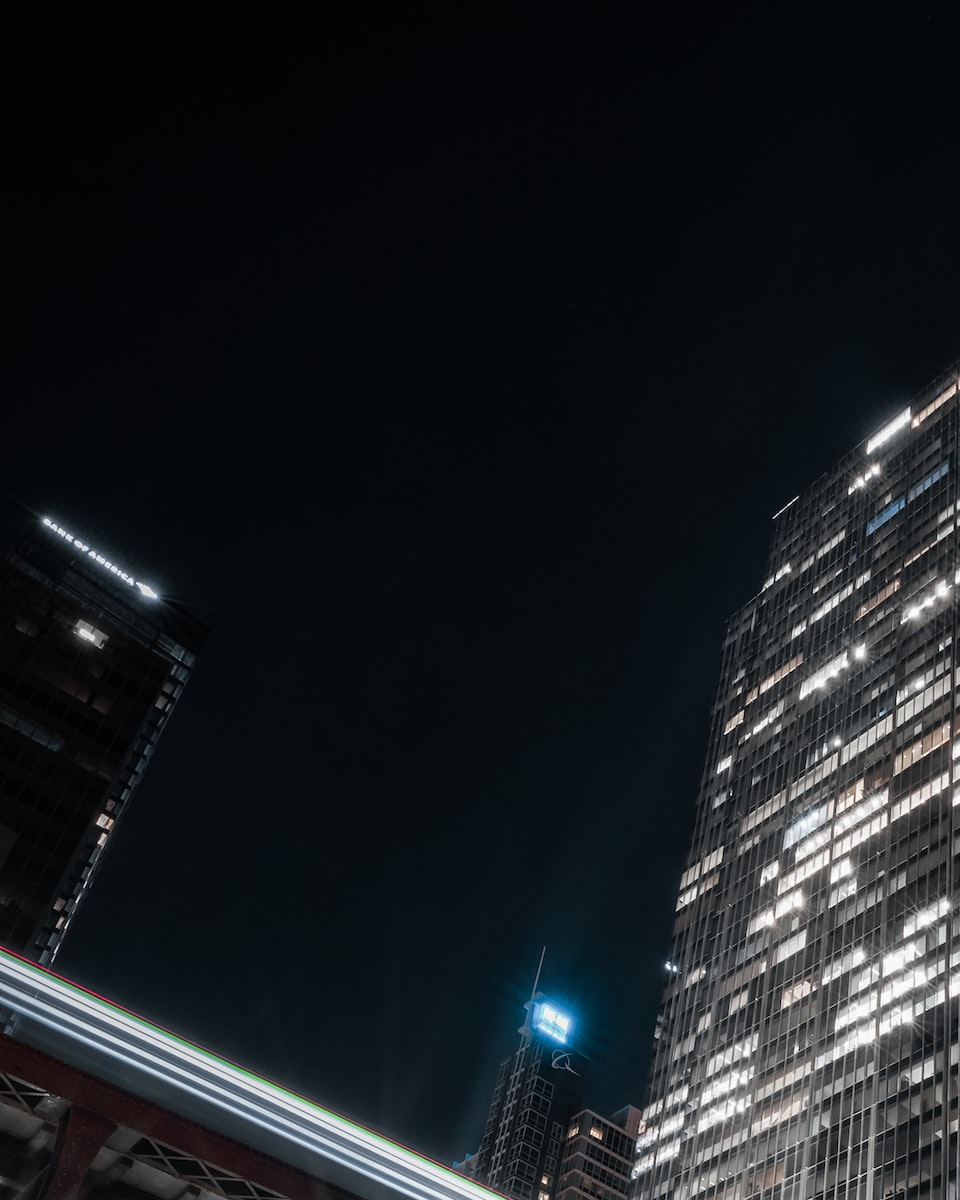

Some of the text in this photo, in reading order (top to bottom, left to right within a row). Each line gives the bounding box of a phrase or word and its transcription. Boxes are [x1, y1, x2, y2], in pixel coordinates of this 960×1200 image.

[43, 518, 134, 586] BANK OF AMERICA
